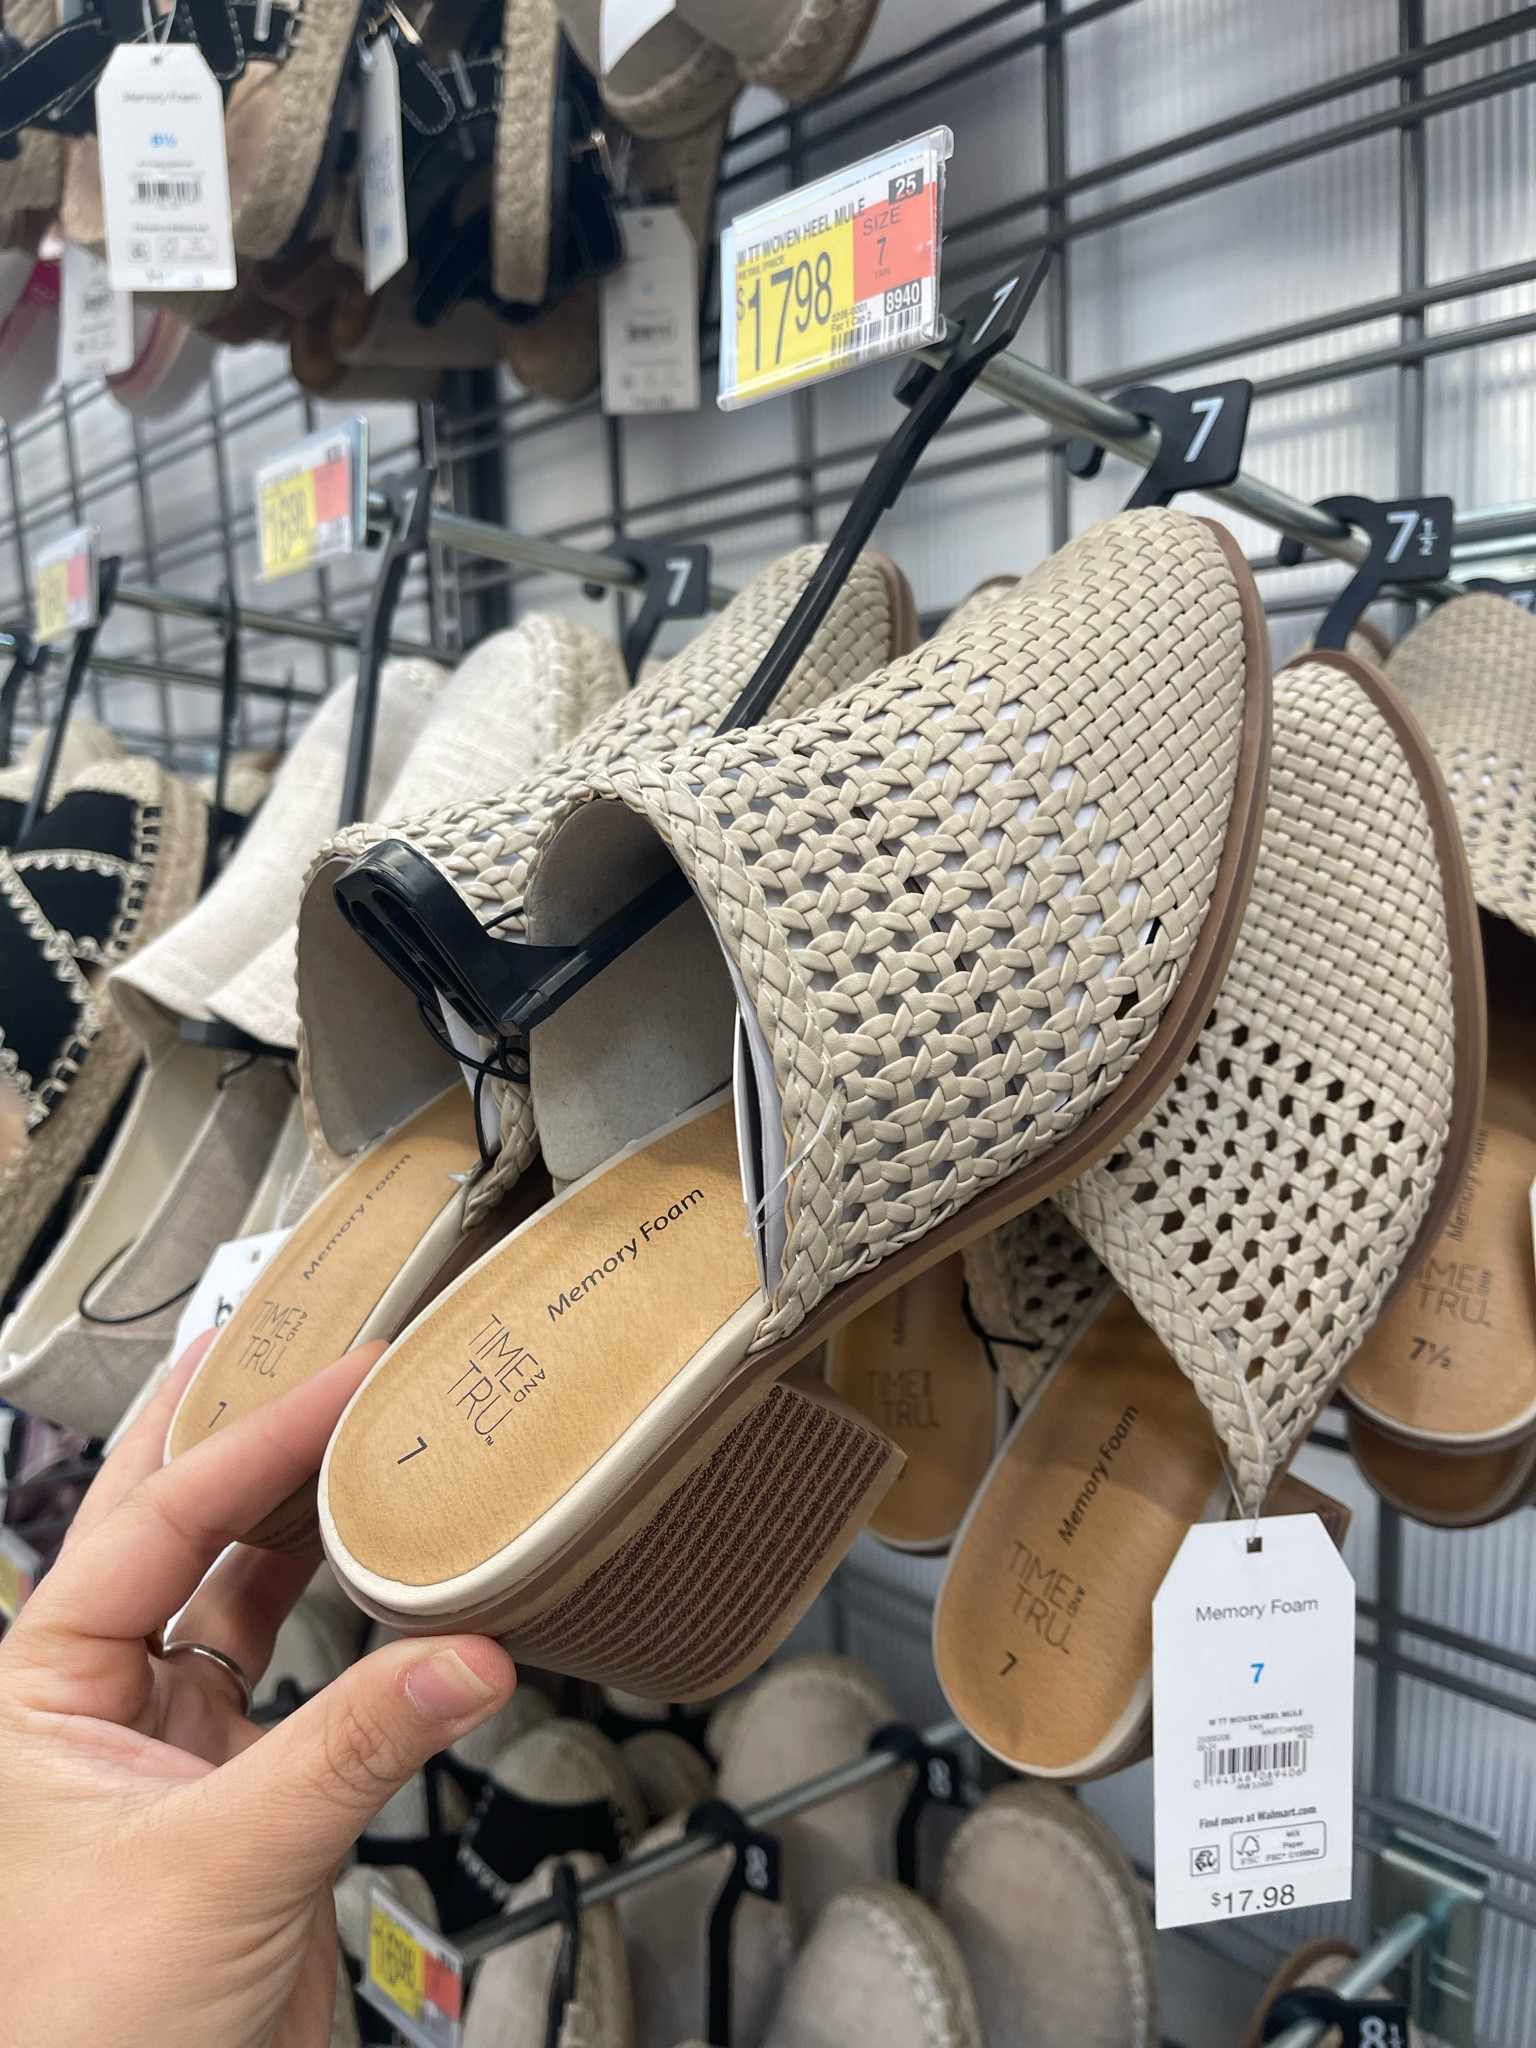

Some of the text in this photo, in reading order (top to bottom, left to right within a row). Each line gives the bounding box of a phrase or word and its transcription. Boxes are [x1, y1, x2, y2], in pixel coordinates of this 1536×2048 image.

[894, 173, 917, 201] 25
[763, 226, 801, 257] WOVEN
[803, 214, 832, 241] HEEL
[834, 197, 866, 227] MULE
[863, 205, 902, 236] SIZE
[763, 255, 785, 271] PRICE
[876, 236, 887, 266] 7
[885, 282, 920, 313] 8940
[972, 276, 1020, 345] 7
[1184, 397, 1224, 463] 7
[664, 556, 694, 607] 7
[303, 1153, 412, 1281] Memory Foam
[547, 1187, 705, 1322] Memory Foam
[256, 1300, 303, 1339] TIME
[286, 1311, 308, 1341] AND
[468, 1314, 546, 1402] TIME AND
[209, 1401, 227, 1429] 7
[397, 1436, 428, 1465] 7
[1058, 1405, 1139, 1546] Memory Foam
[1009, 1540, 1074, 1611] TIME
[1196, 1598, 1318, 1623] Memory Foam
[999, 1650, 1018, 1676] 7
[1250, 1662, 1265, 1684] 7
[927, 1757, 952, 1798] 8
[1198, 1806, 1317, 1829] Find more at Walmart.com
[743, 1845, 768, 1891] 8
[1211, 1884, 1296, 1914] $17.98
